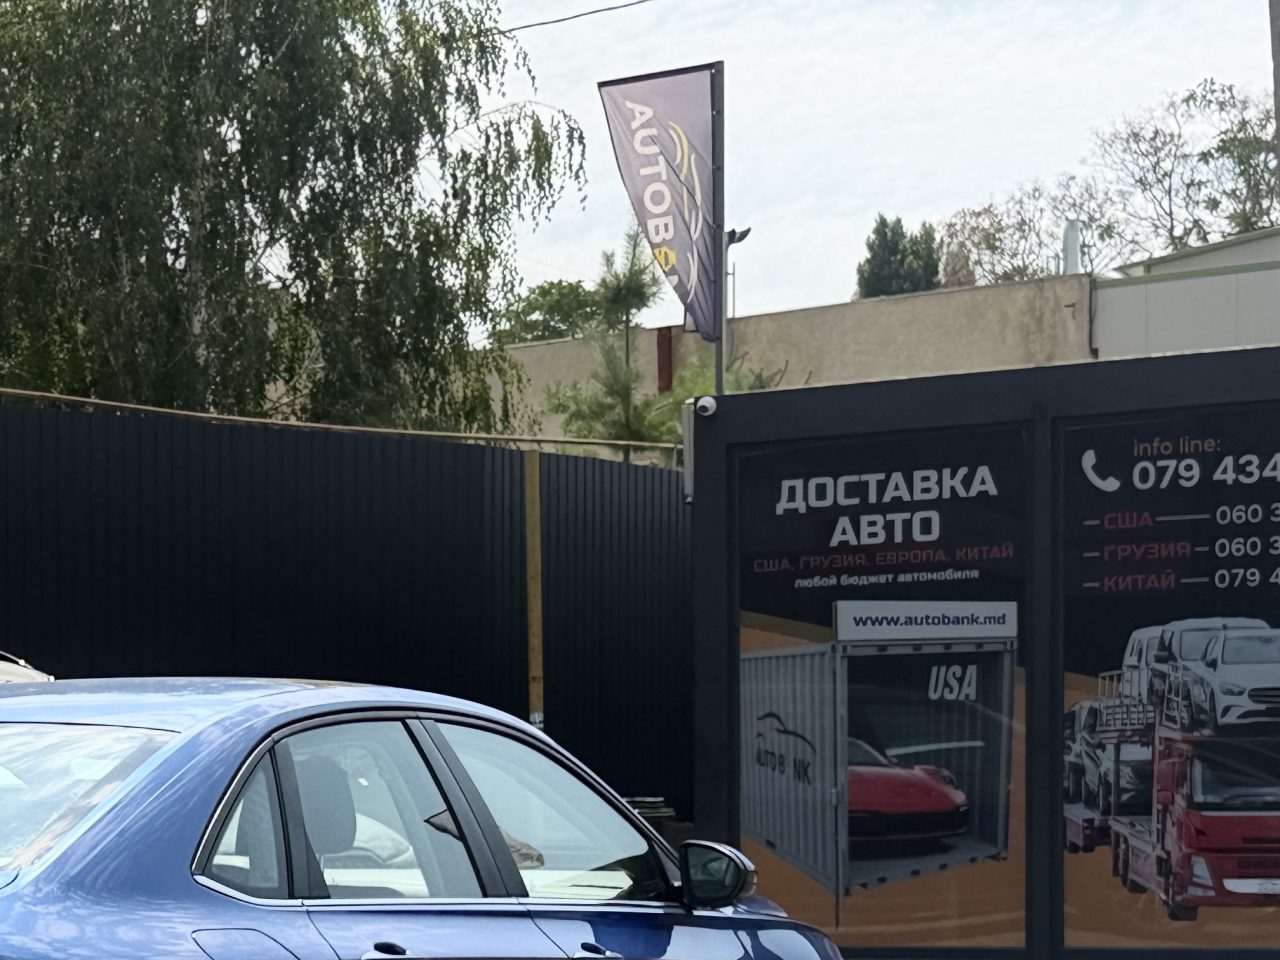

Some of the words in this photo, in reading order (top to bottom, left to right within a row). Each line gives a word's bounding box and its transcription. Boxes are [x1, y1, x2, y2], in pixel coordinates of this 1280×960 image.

[1133, 437, 1173, 457] info
[1179, 435, 1221, 455] line:
[1132, 458, 1201, 490] 079
[1212, 452, 1280, 486] 434
[775, 465, 999, 515] ДОСТАВКА
[829, 510, 941, 547] АВТО
[1103, 511, 1153, 530] США
[1215, 503, 1263, 526] 060
[955, 542, 1014, 561] КИТАЙ
[1103, 541, 1192, 562] ГРУЗИЯ
[1214, 536, 1262, 558] 060
[794, 574, 837, 589] любой
[840, 573, 894, 586] бюджет
[897, 568, 979, 583] автомобиля
[1103, 569, 1176, 592] КИТАЙ
[1214, 567, 1261, 589] 079
[852, 613, 1007, 627] www.autobank.md
[928, 664, 977, 701] USA
